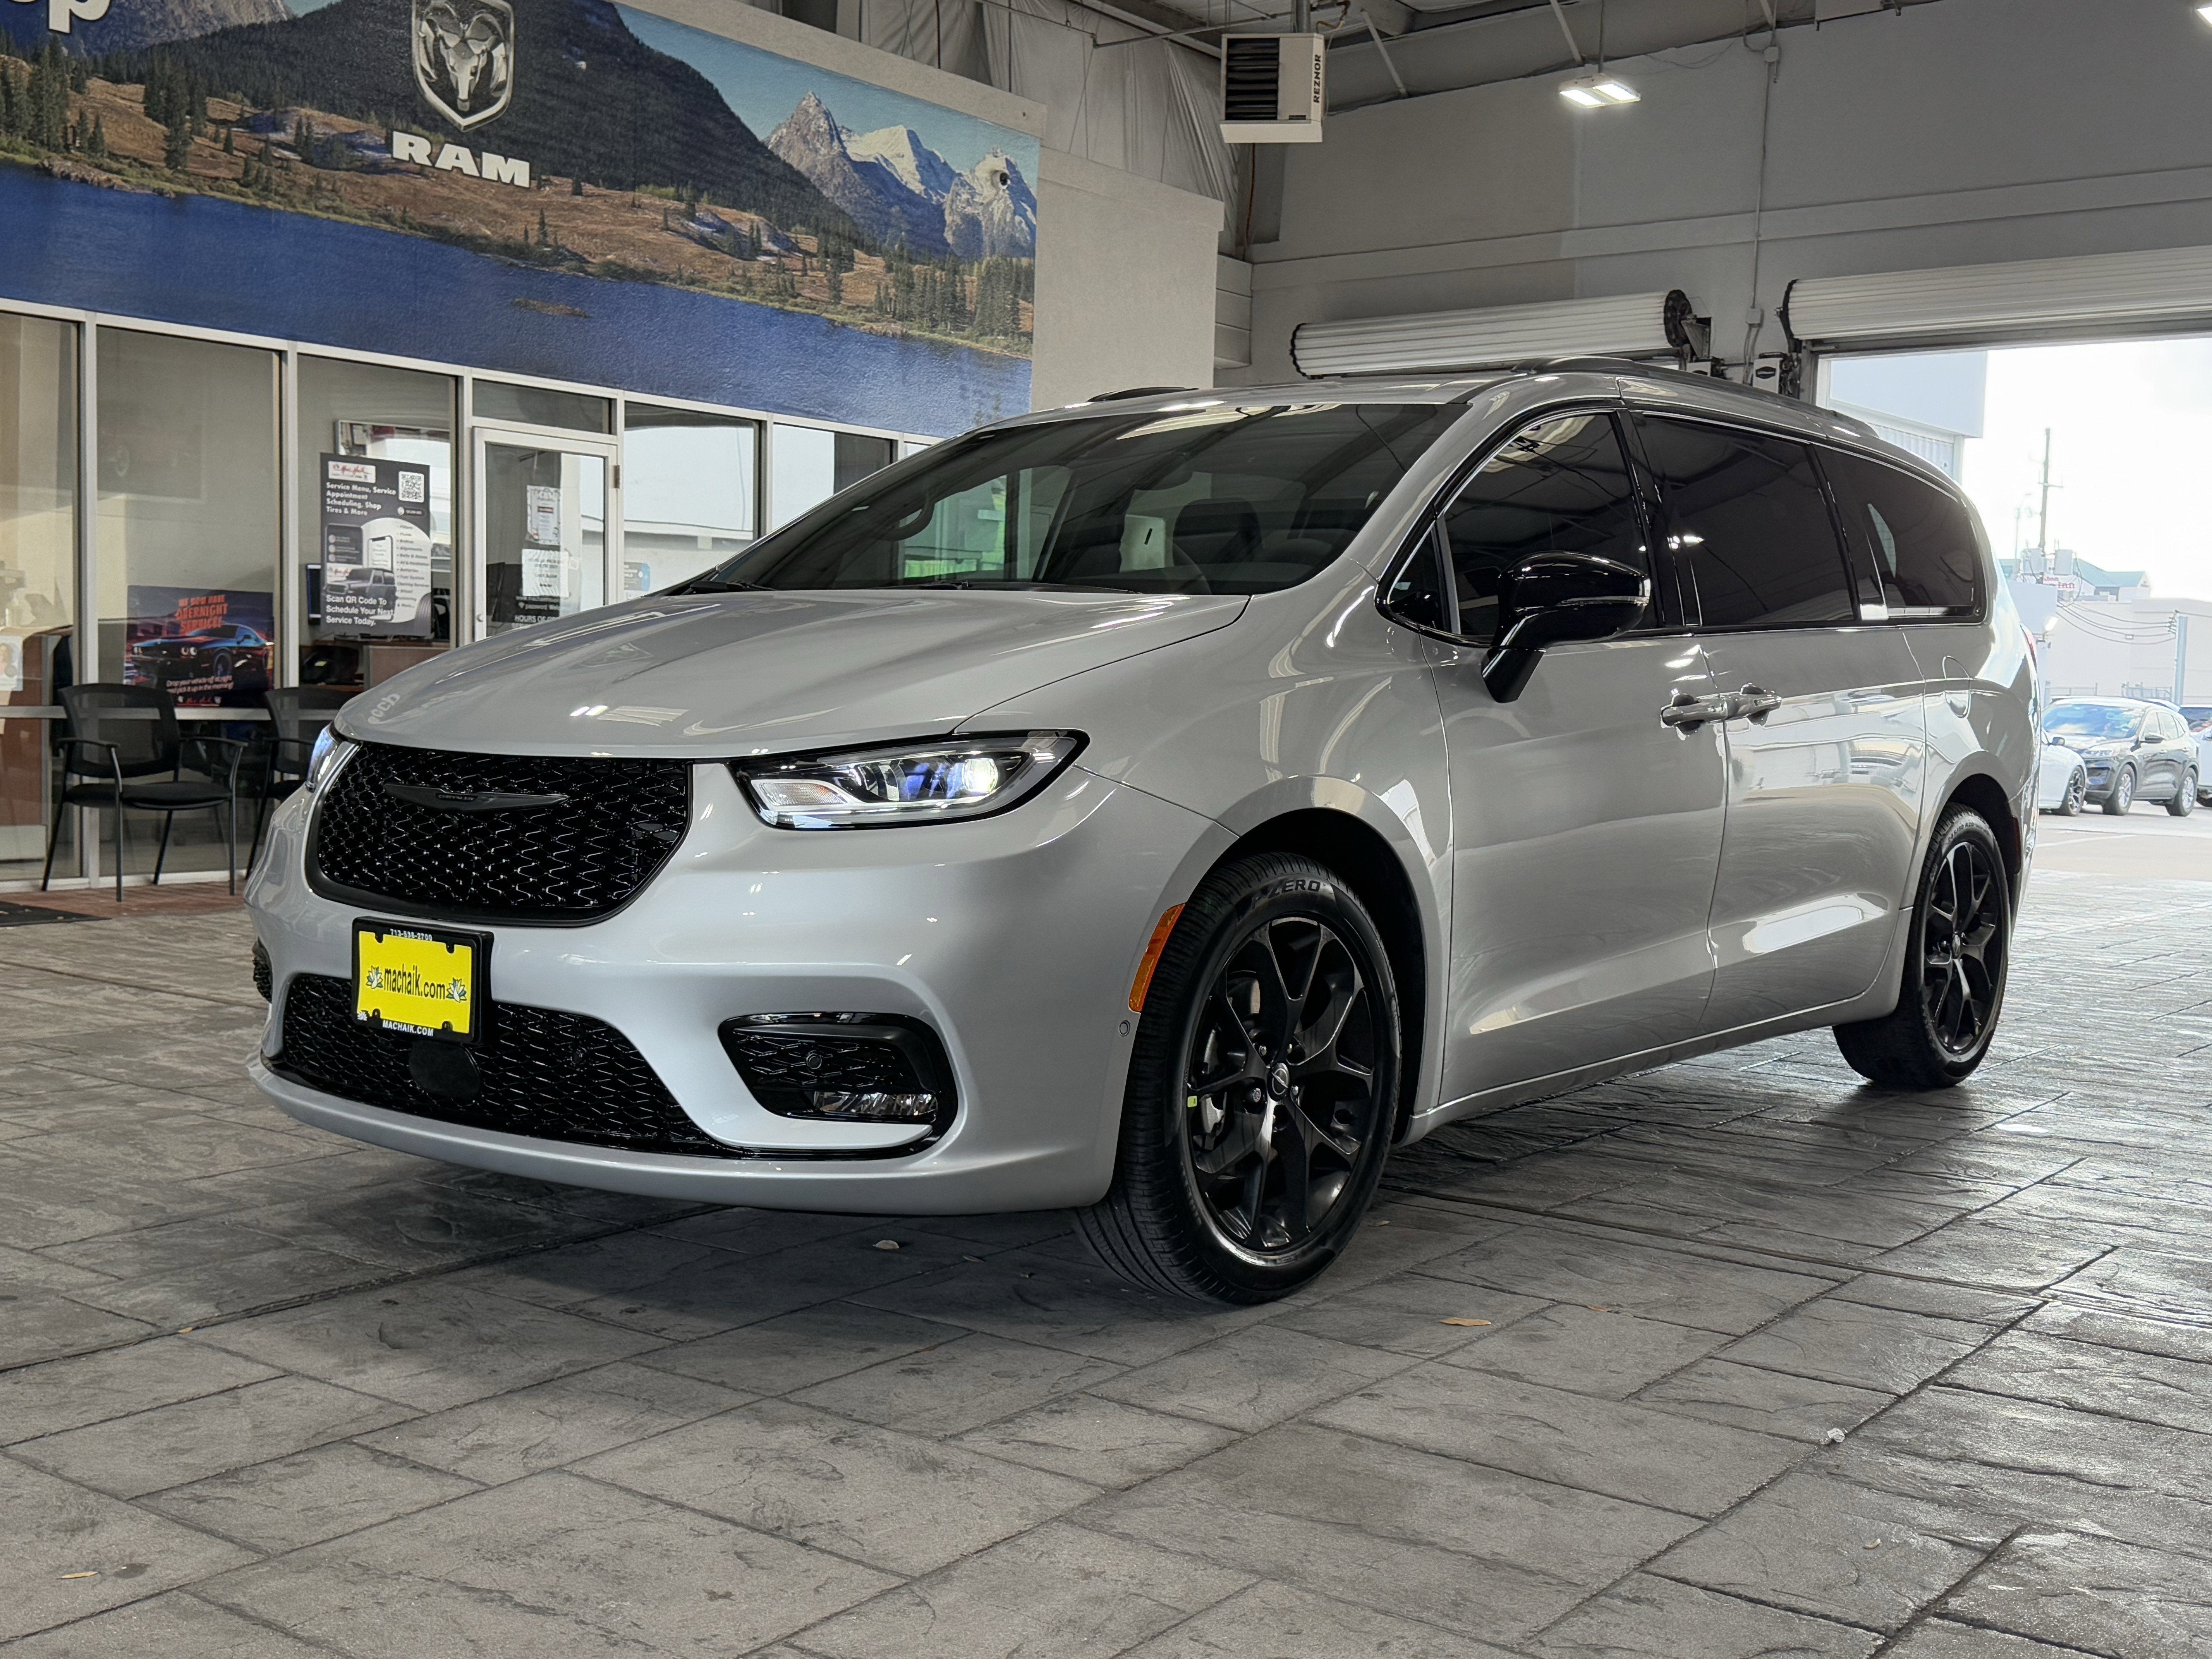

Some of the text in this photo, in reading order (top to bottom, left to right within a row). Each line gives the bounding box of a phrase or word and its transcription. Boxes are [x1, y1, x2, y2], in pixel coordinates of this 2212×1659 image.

[1313, 54, 1321, 103] REZNOR
[393, 131, 530, 188] RAM
[326, 482, 396, 495] Service Menu, Service
[326, 490, 368, 500] Appointment
[326, 498, 381, 510] Scheduling, Shop
[326, 594, 344, 603] Scan
[345, 596, 357, 604] QR
[358, 596, 377, 605] Code
[175, 603, 228, 620] OVERNIGHT
[326, 605, 359, 614] Schedule
[326, 615, 376, 627] Service Today.
[1267, 879, 1321, 899] ZERO
[384, 963, 445, 1000] machaik.com
[382, 1019, 434, 1037] MACHAIK.COM
